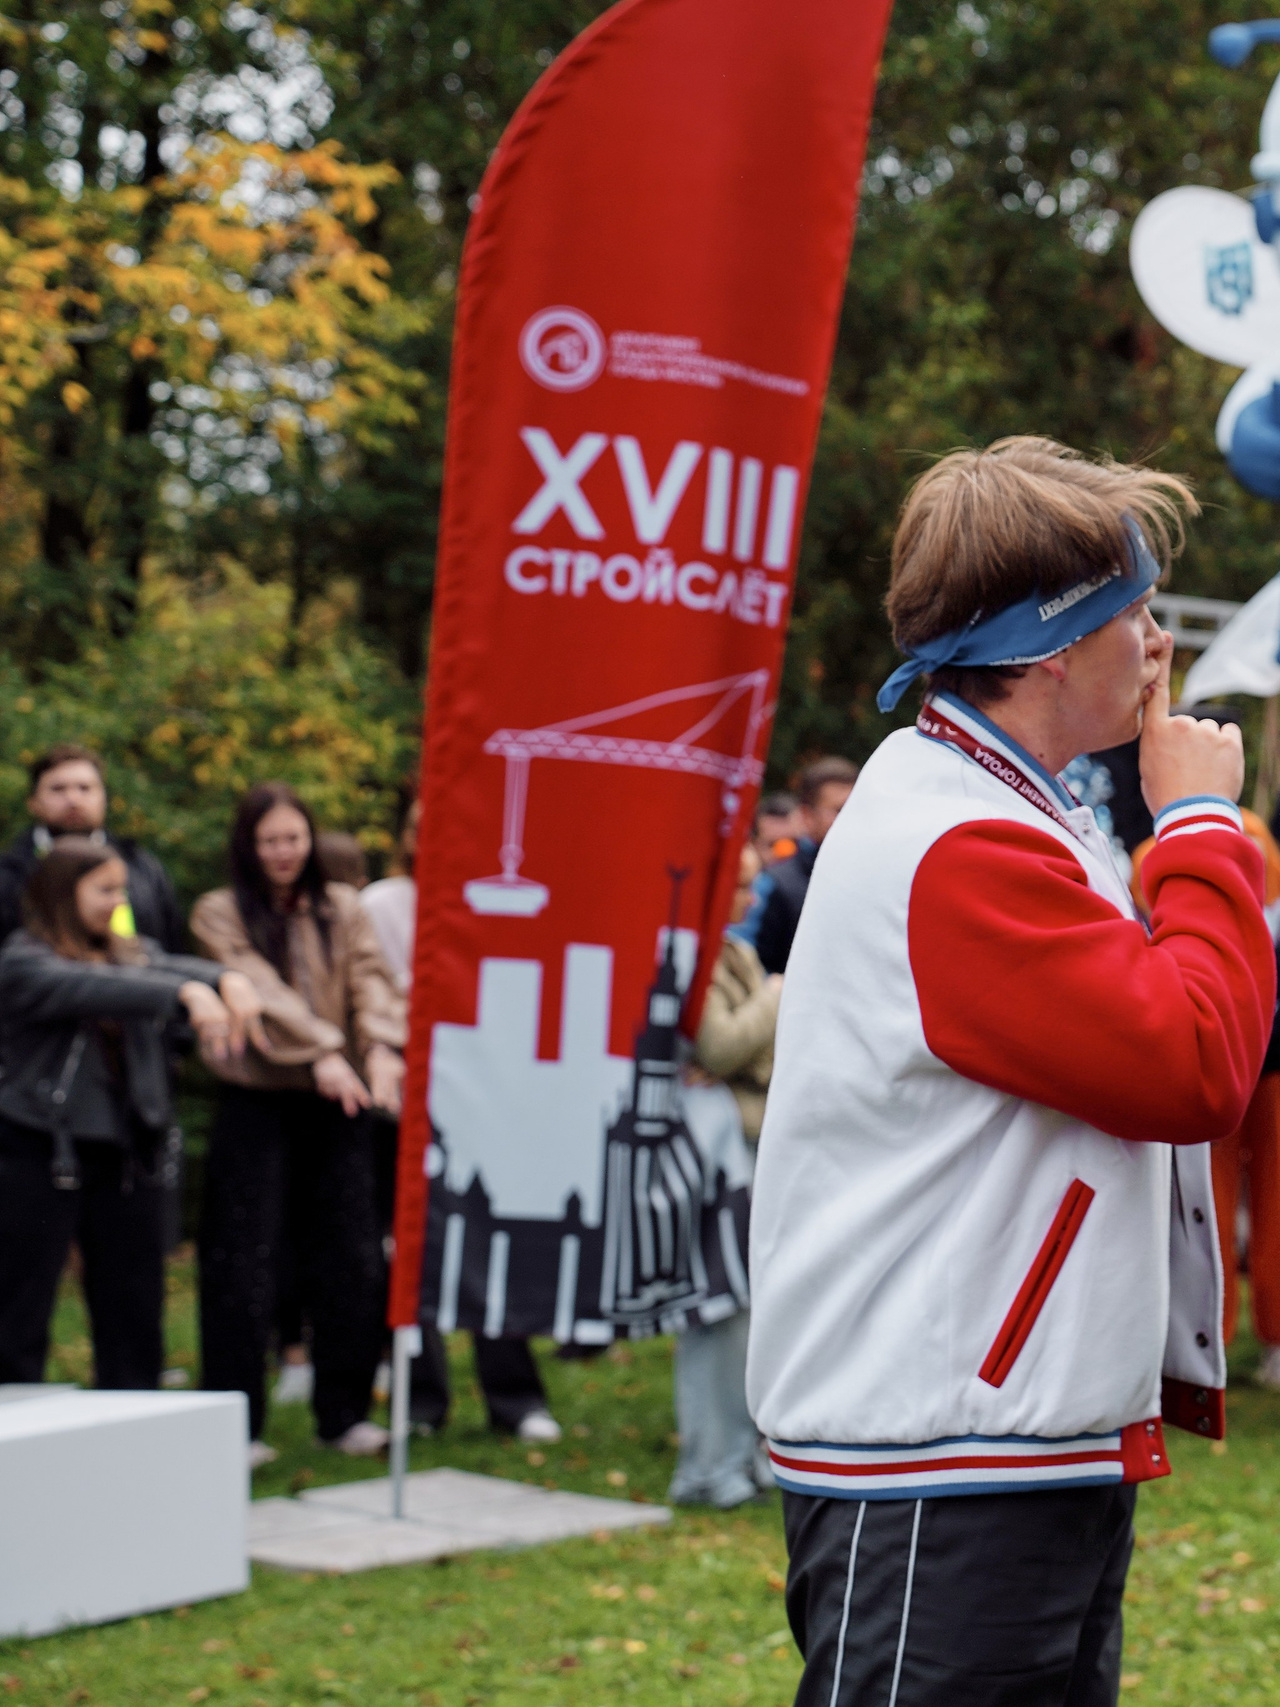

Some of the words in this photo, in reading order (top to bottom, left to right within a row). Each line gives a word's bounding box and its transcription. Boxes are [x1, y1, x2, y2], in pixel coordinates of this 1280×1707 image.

[511, 425, 800, 571] XVIII
[503, 545, 788, 628] СТРОЙСЛЁТ
[974, 747, 1022, 788] ГОРОДА
